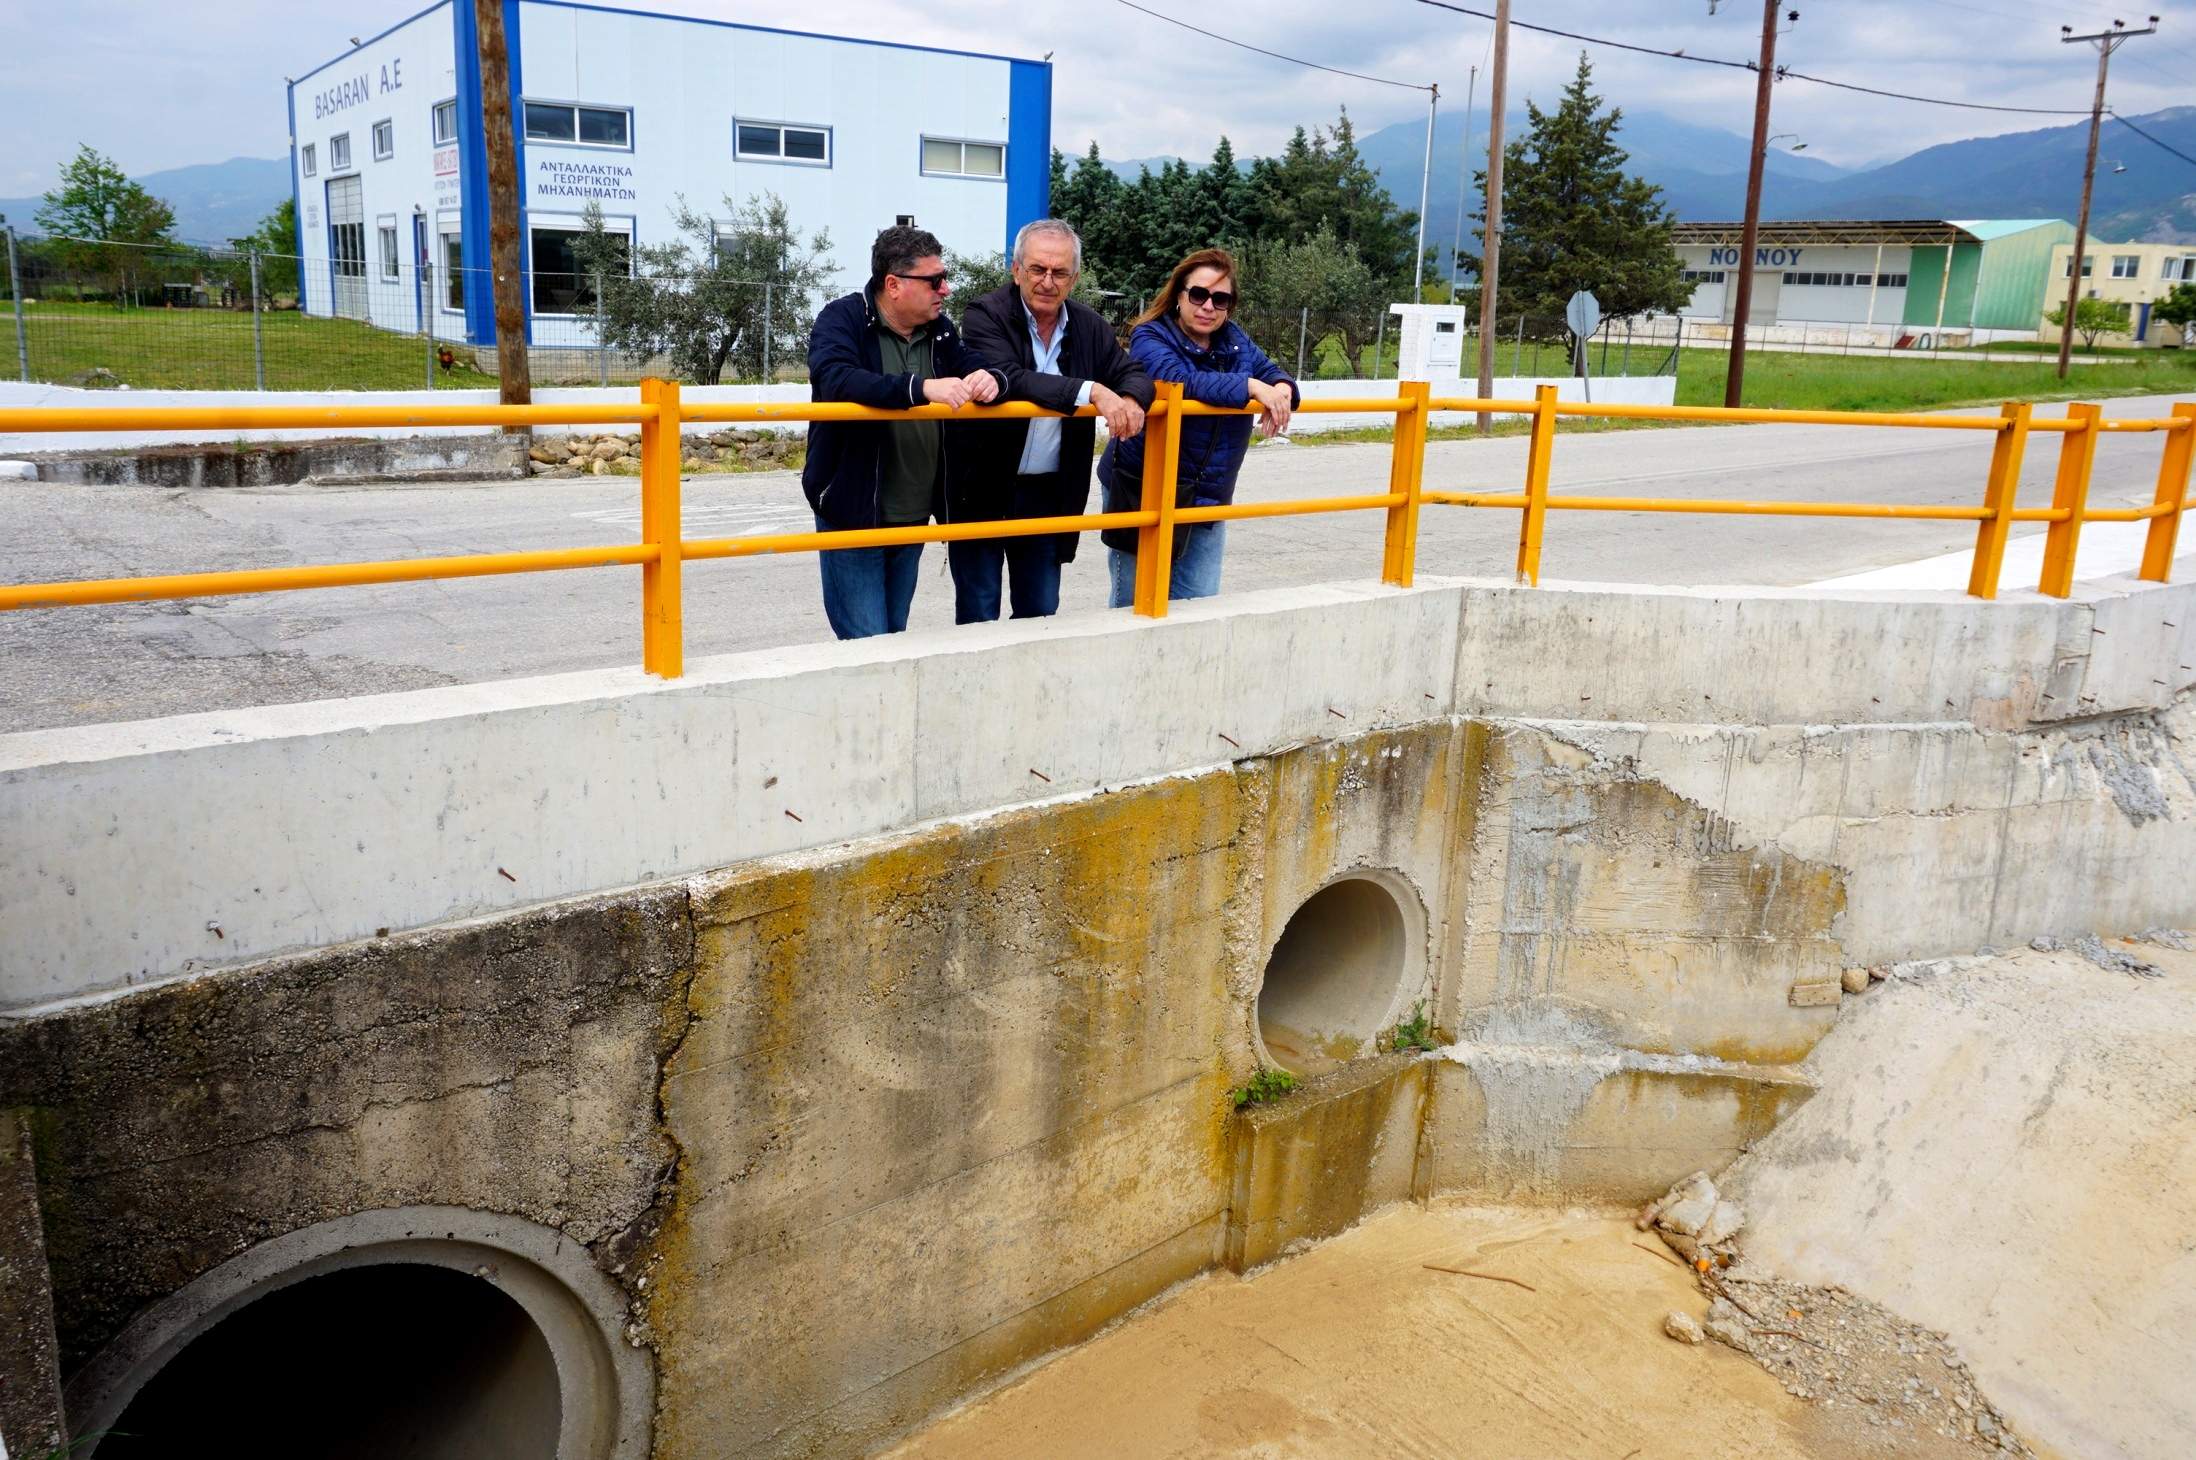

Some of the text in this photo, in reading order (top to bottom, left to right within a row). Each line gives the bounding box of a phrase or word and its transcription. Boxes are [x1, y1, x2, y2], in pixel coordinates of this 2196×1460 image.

[315, 72, 368, 119] BASARAN
[540, 161, 632, 176] ΑΝΤΑΛΛΑΚΤΙΚΑ
[553, 173, 620, 187] ΓΕΩΡΓΙΚΩΝ
[538, 183, 635, 200] ΜΗΧΑΝΗΜΑΤΩΝ
